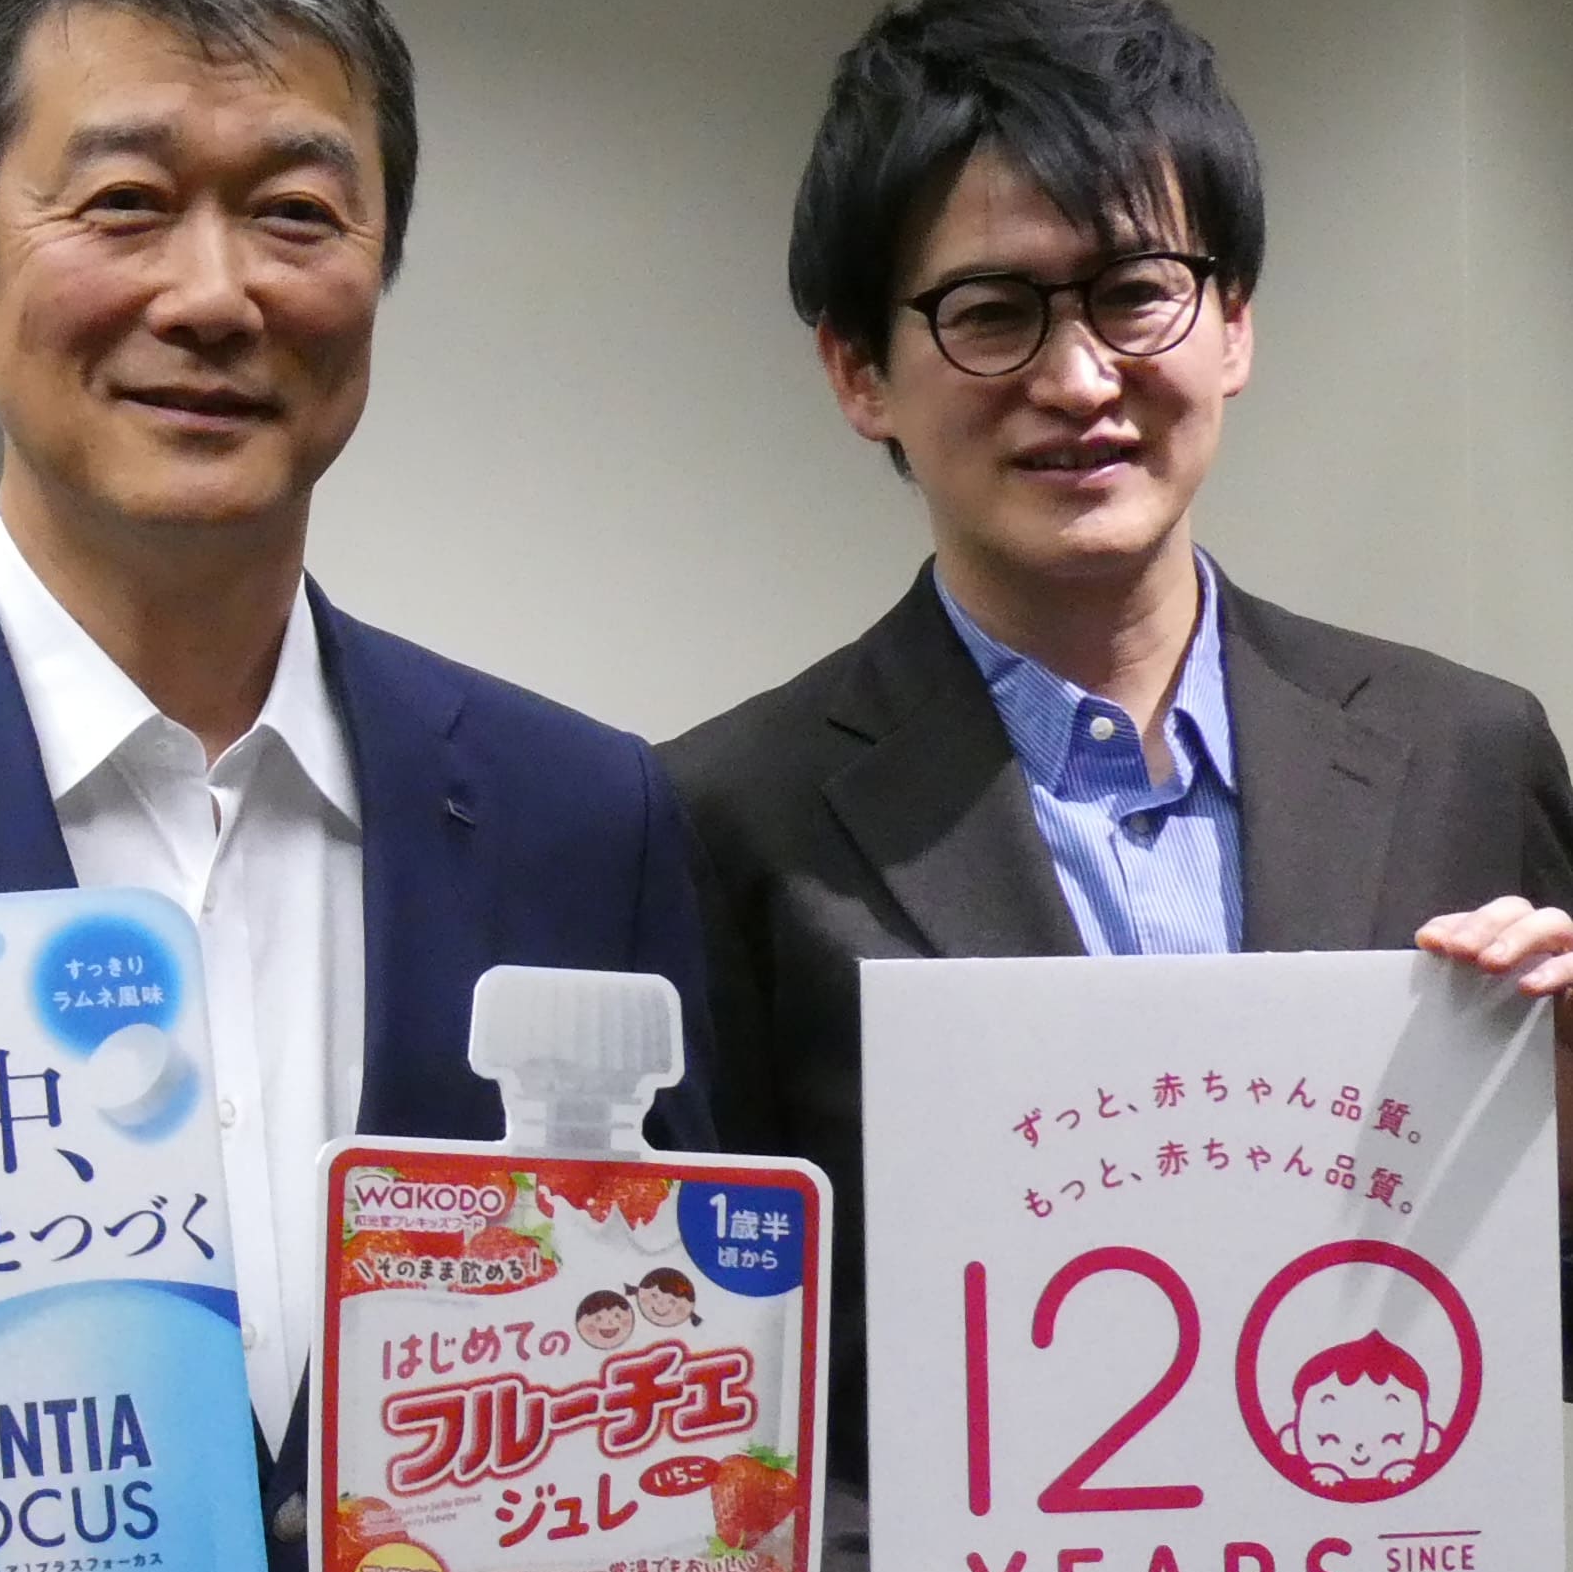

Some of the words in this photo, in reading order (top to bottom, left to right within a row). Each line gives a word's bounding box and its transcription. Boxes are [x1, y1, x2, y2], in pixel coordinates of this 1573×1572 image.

[65, 955, 145, 980] すっきり
[52, 984, 166, 1013] ラムネ風味
[1011, 1069, 1422, 1149] ずっと、赤ちゃん品質。
[1023, 1136, 1414, 1219] もっと、赤ちゃん品質。
[708, 1192, 791, 1242] 1歳半
[717, 1246, 780, 1271] 頃から
[381, 1321, 572, 1382] はじめての
[963, 1238, 1483, 1518] 120
[383, 1341, 757, 1495] フルーチェ
[652, 1463, 708, 1489] いちご
[494, 1471, 641, 1549] ジュレ
